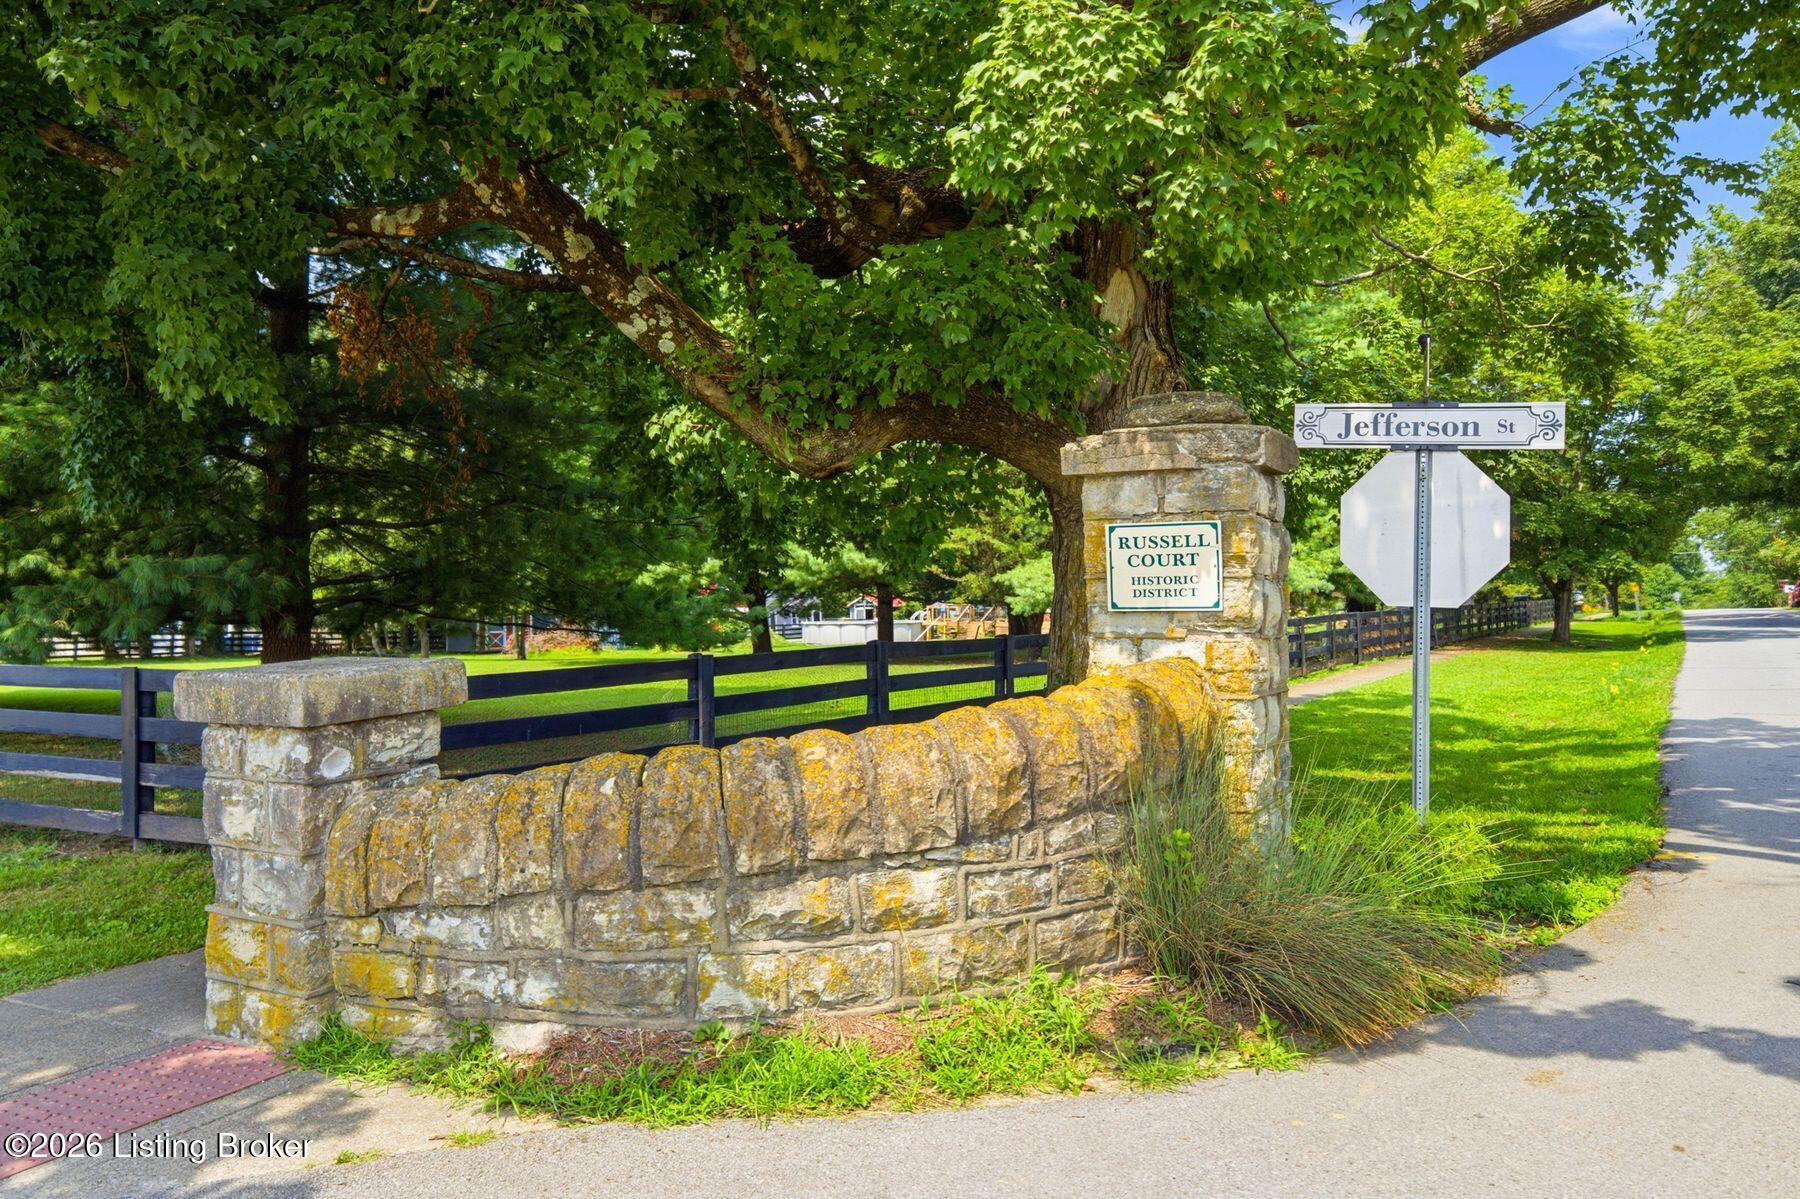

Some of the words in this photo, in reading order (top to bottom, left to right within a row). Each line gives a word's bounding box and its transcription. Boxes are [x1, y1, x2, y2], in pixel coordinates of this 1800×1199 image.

[1337, 412, 1481, 440] Jefferson
[1497, 418, 1516, 434] St
[1118, 533, 1211, 550] RUSSELL
[1127, 552, 1200, 568] COURT
[1131, 574, 1200, 586] HISTORIC
[1132, 587, 1198, 598] DISTRICT
